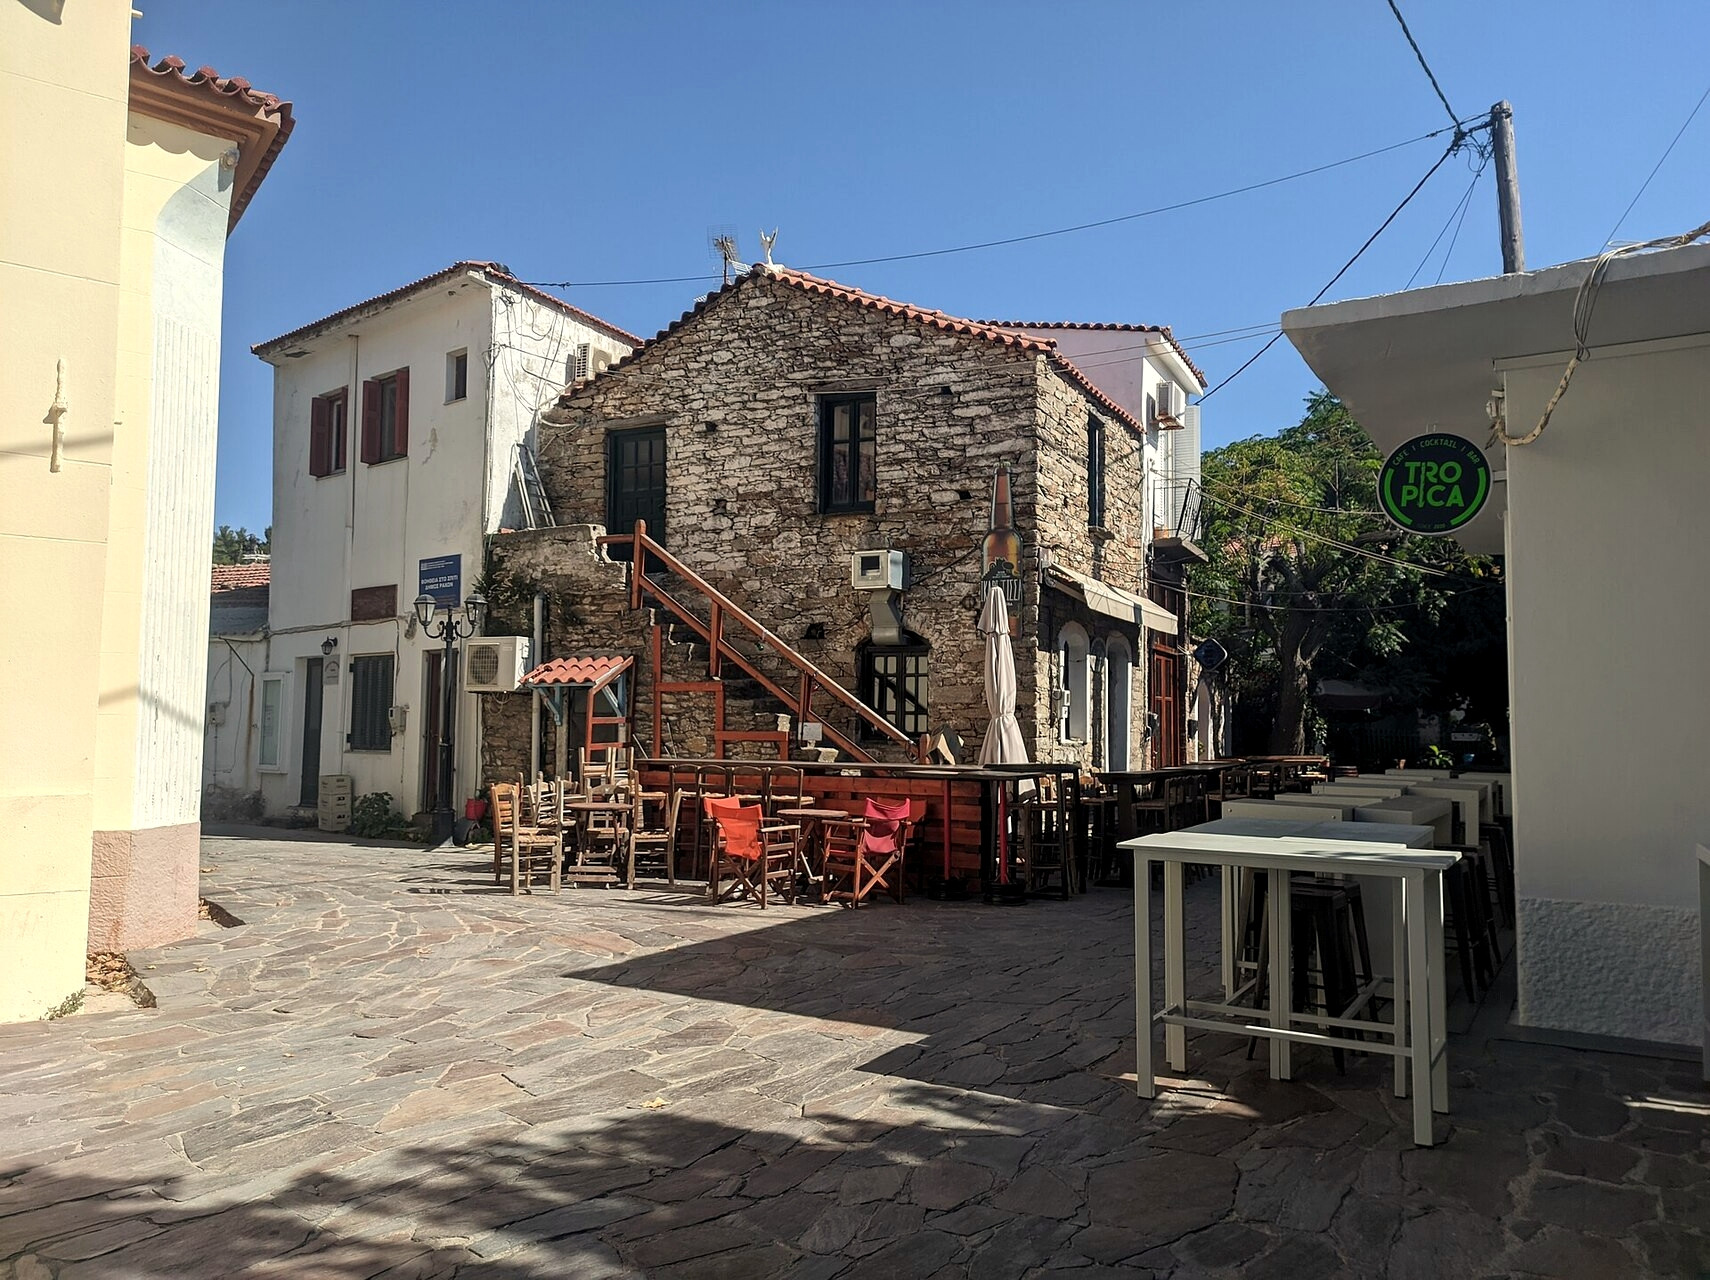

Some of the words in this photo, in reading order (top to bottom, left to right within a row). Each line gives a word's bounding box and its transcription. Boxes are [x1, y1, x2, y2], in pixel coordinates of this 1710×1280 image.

[1392, 449, 1409, 466] CAFE
[1420, 438, 1457, 449] COCKTAIL
[1466, 450, 1480, 464] BAR
[1404, 461, 1462, 484] TRO
[1401, 484, 1464, 508] PICA
